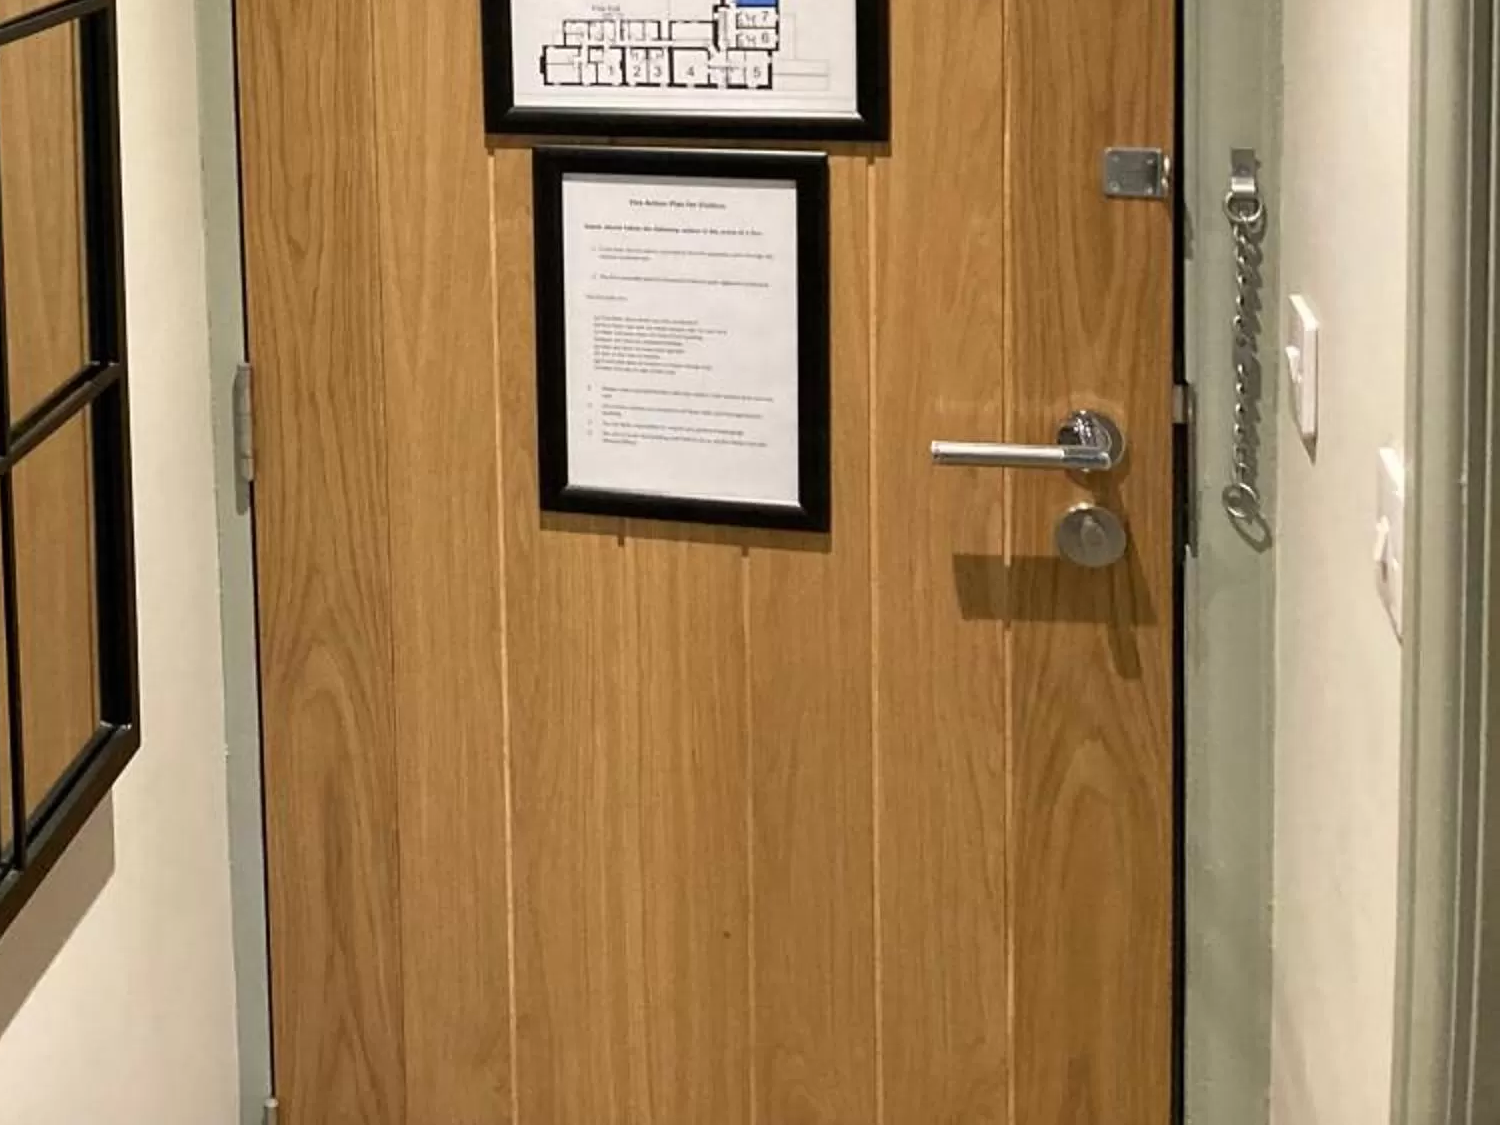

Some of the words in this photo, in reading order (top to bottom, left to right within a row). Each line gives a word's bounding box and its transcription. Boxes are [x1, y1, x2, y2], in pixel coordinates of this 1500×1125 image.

[761, 11, 769, 23] 7
[761, 33, 769, 44] 6
[632, 65, 641, 77] 2
[653, 66, 663, 77] 3
[686, 65, 695, 77] 4
[753, 66, 761, 79] 5
